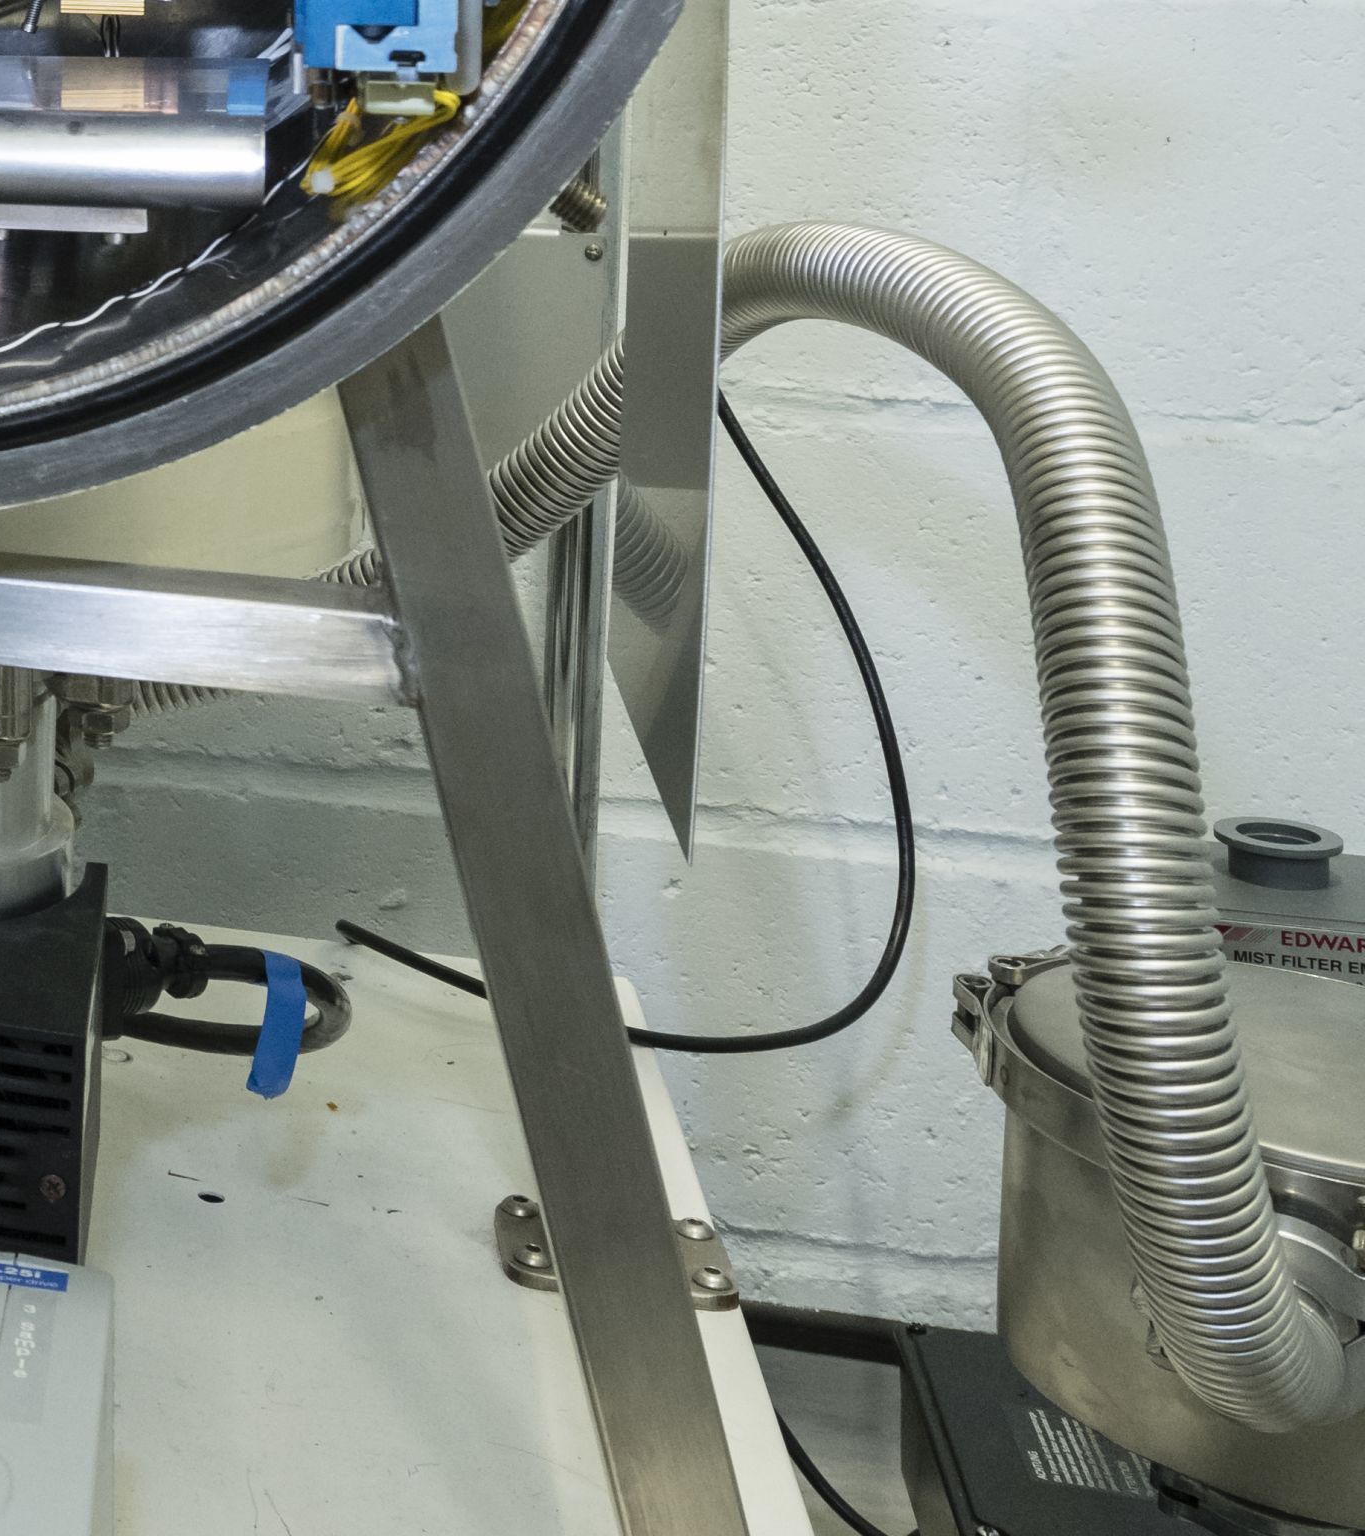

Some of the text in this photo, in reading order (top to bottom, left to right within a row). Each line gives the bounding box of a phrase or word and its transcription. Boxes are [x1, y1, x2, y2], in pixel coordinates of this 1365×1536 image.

[1233, 950, 1275, 966] MIST
[1281, 954, 1342, 973] FILTER
[24, 1277, 59, 1289] drive
[12, 1321, 36, 1378] Sample
